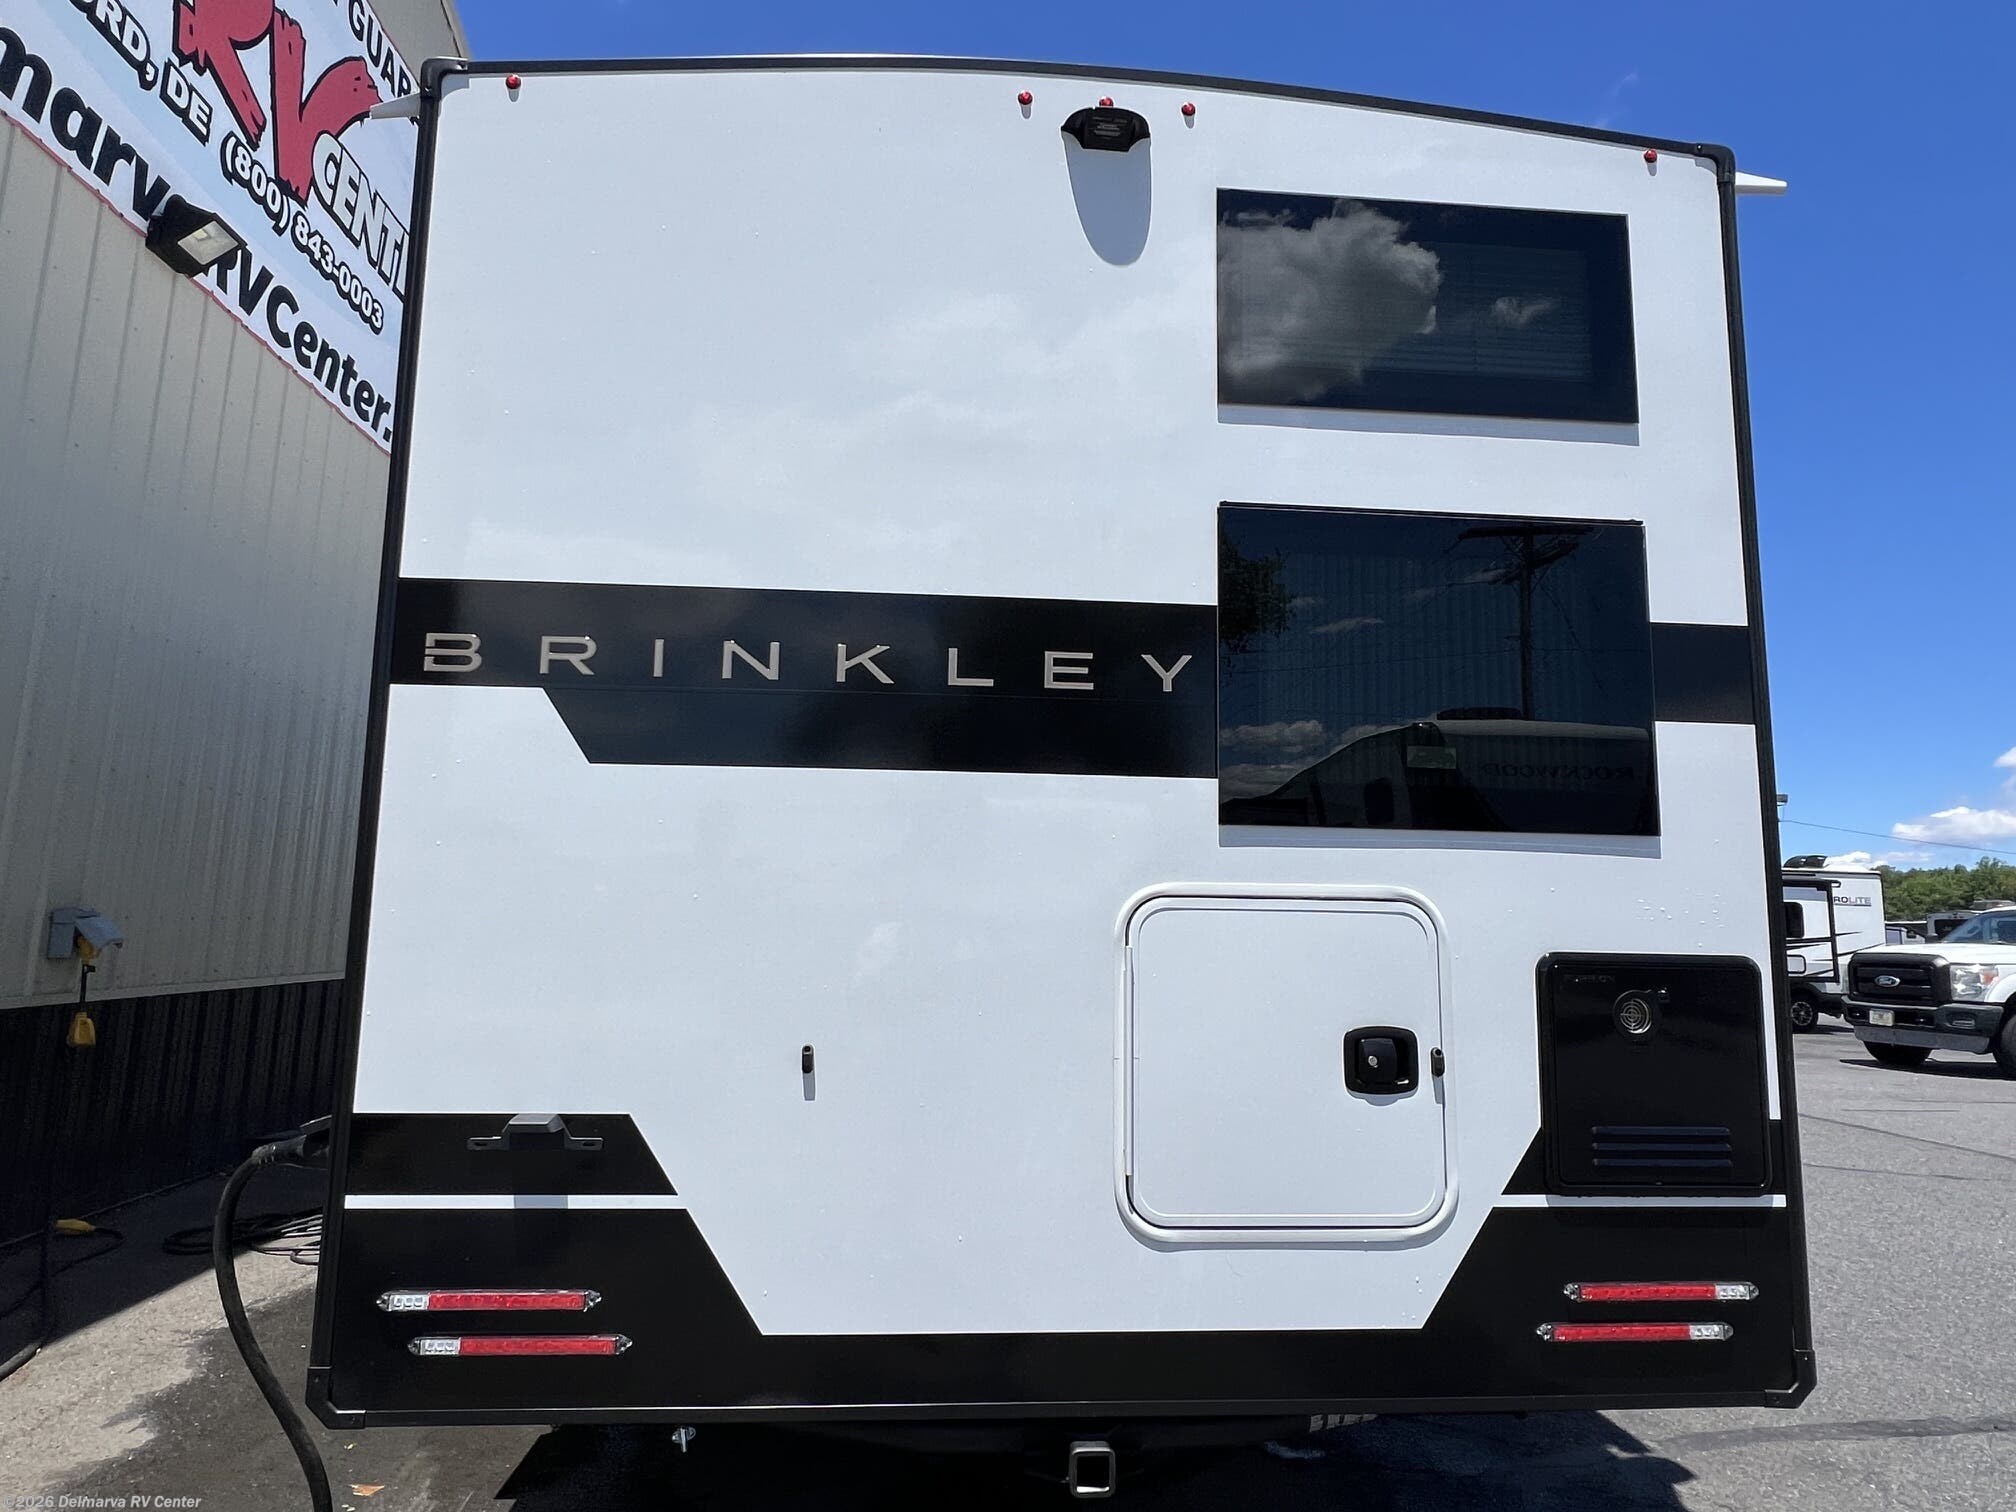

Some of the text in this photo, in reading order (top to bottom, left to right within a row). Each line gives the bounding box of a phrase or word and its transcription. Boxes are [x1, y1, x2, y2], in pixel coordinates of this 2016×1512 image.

[70, 0, 384, 335] RD, DE (800) 843-0003
[423, 631, 1193, 693] BRINKLEY
